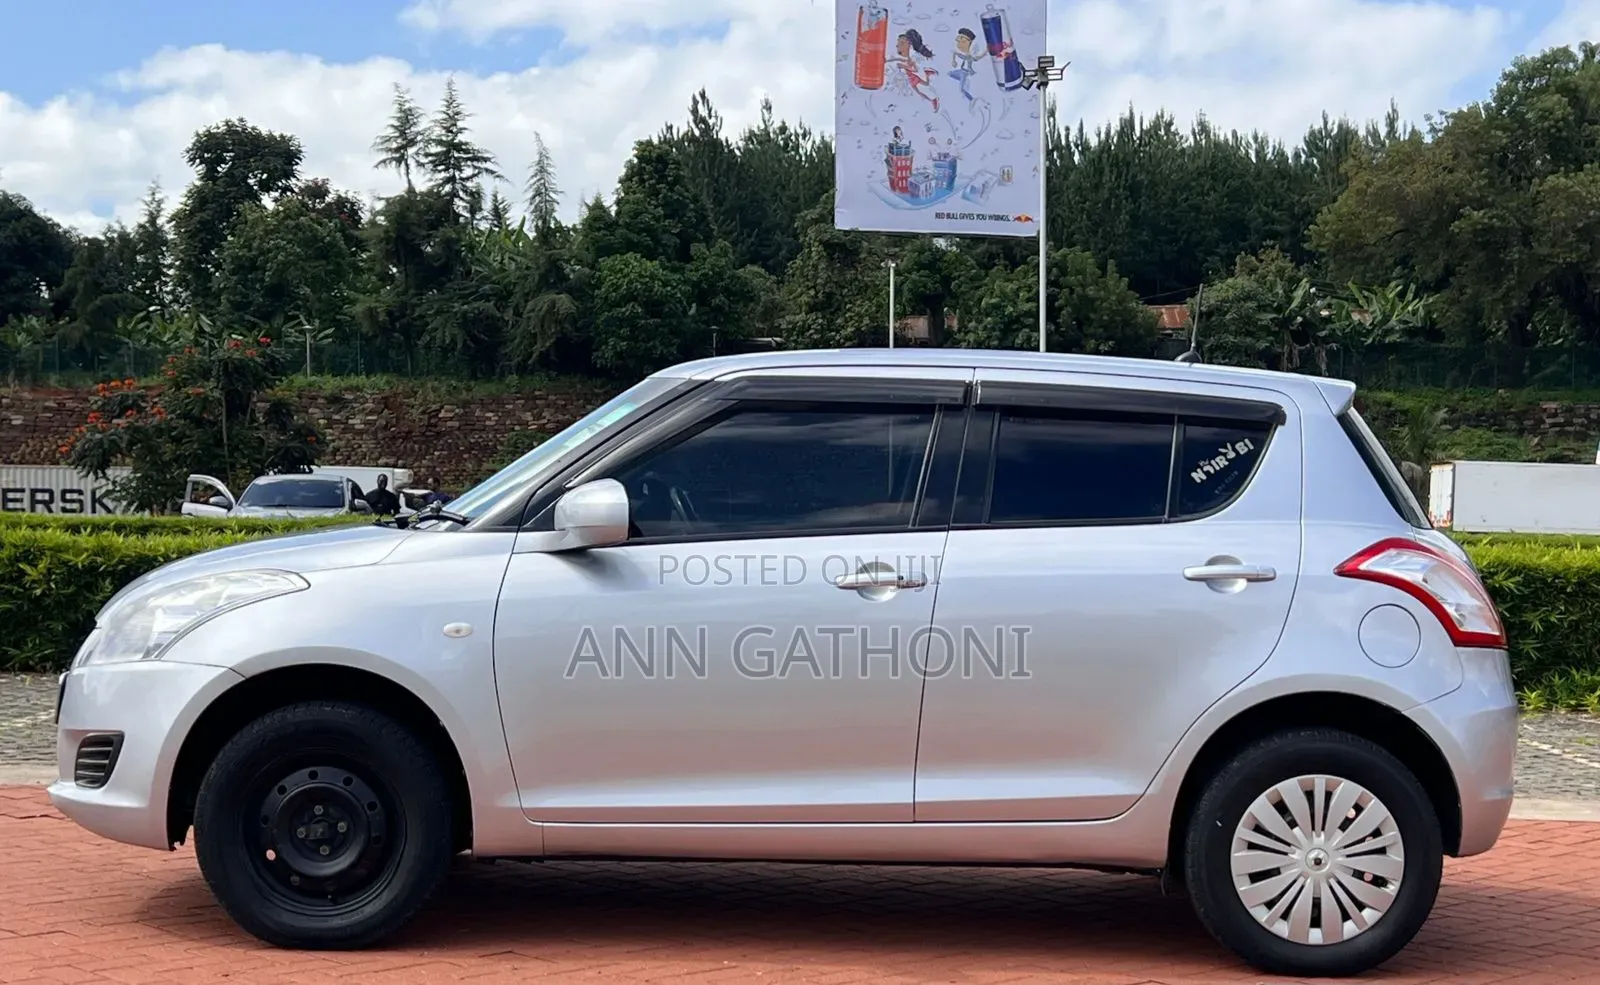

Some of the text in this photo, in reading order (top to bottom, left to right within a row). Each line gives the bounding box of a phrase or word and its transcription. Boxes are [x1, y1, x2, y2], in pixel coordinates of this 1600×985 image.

[935, 212, 945, 220] RED
[946, 212, 958, 220] BULL
[959, 212, 974, 221] GIVES
[975, 213, 988, 221] YOU
